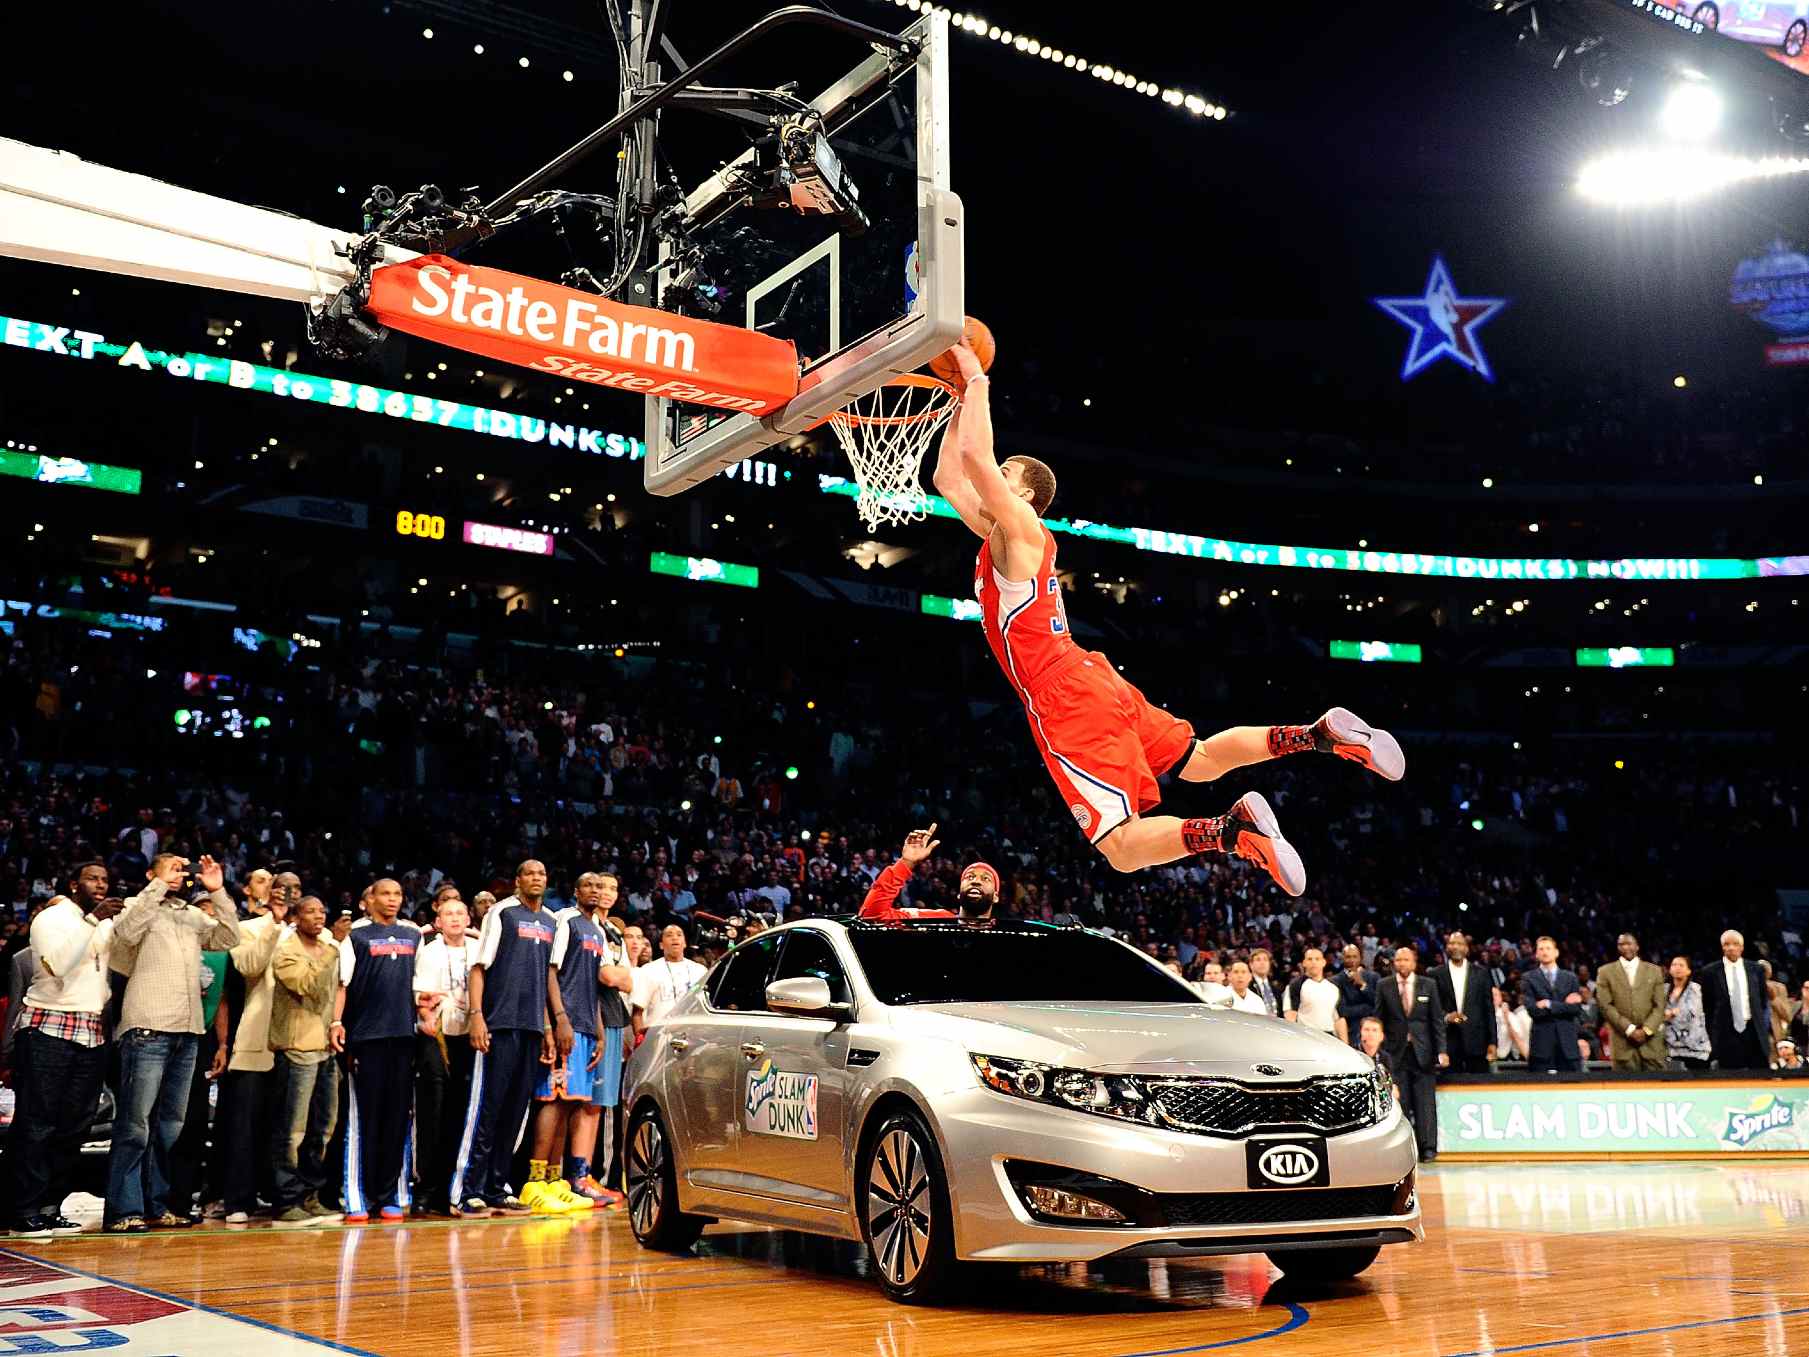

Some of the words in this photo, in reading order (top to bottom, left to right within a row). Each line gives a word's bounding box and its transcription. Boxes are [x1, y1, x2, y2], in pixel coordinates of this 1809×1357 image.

[118, 341, 152, 371] A
[167, 357, 212, 381] or
[229, 359, 255, 389] B
[271, 373, 313, 400] to
[529, 354, 657, 391] State
[646, 380, 767, 412] Farm
[396, 510, 445, 540] 8:00
[1131, 527, 1206, 558] TEXT
[1213, 540, 1233, 562] A
[778, 1076, 807, 1101] SLAM
[768, 1101, 806, 1135] DUNK
[1457, 1102, 1569, 1140] SLAM
[1577, 1102, 1699, 1139] DUNK
[1729, 1100, 1791, 1143] Sprite
[1269, 1153, 1310, 1176] KIA
